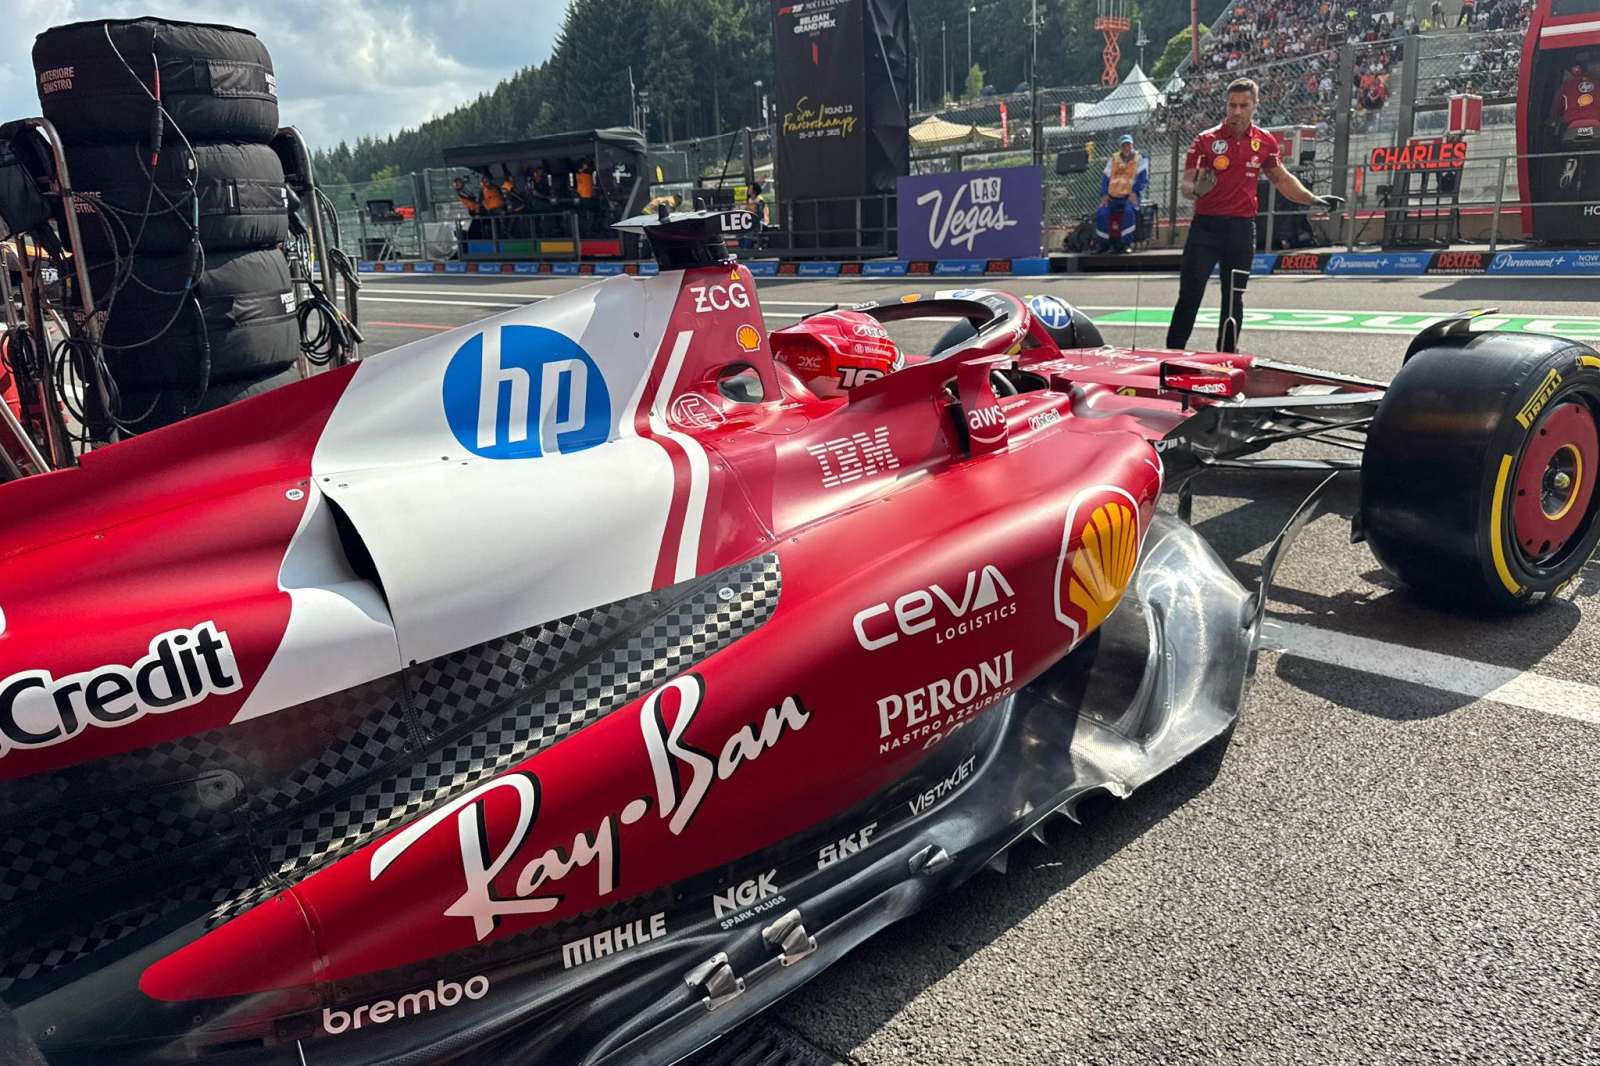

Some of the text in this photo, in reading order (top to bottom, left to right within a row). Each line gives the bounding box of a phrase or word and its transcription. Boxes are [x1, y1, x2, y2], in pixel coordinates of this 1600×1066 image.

[794, 23, 818, 34] GRAND
[819, 19, 836, 29] PRIX
[1371, 143, 1466, 171] CHARLES
[972, 179, 999, 201] LAS
[720, 213, 753, 231] LEC
[917, 184, 1017, 252] Vegas
[1281, 255, 1318, 269] DEXTER
[1328, 256, 1389, 270] Paramount+
[1438, 253, 1482, 268] DEXTER
[1493, 254, 1566, 270] Paramount+
[690, 283, 750, 313] ZCG
[470, 324, 592, 455] hp
[1515, 368, 1563, 430] PIRELLI
[968, 405, 1006, 431] aws
[807, 426, 900, 488] IBM
[936, 602, 1017, 644] LOGISTICS
[876, 650, 1014, 739] PERONI
[879, 719, 942, 754] NASTRO
[945, 687, 1012, 725] AZZURRO
[816, 822, 879, 872] SKF
[712, 868, 779, 919] NGK
[720, 895, 787, 931] SPARK PLUGS
[562, 912, 667, 969] MAHLE
[322, 975, 489, 1035] brembo
